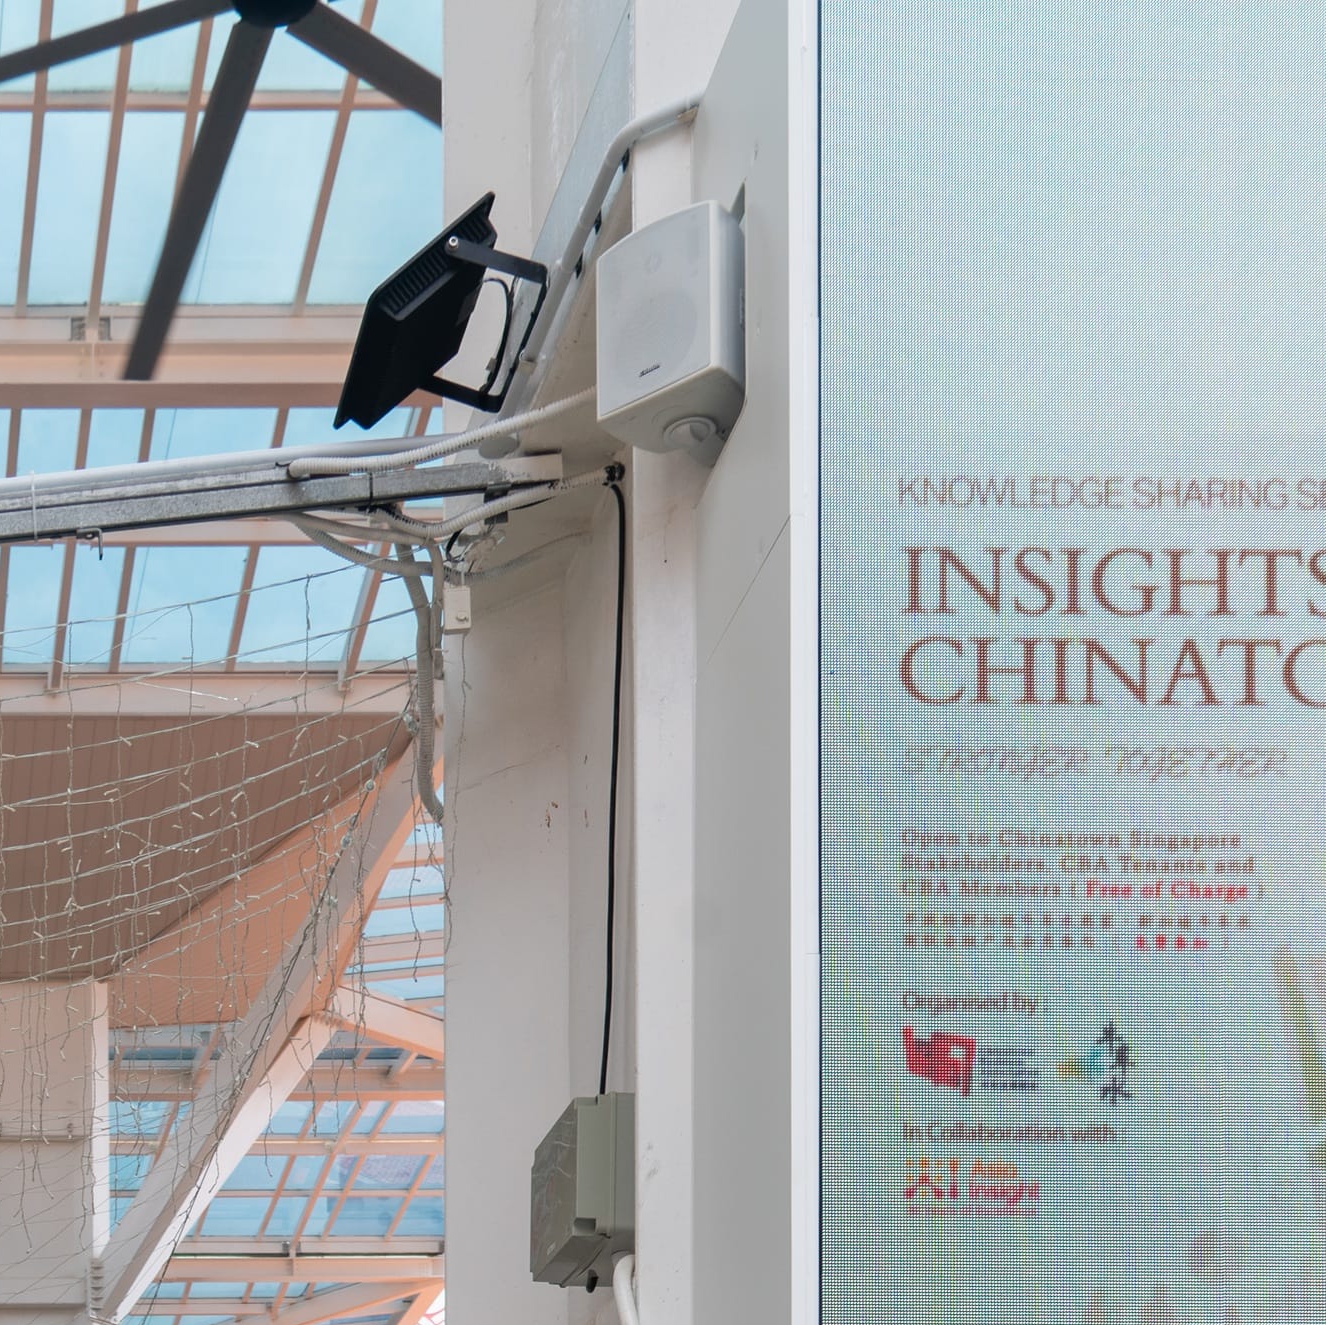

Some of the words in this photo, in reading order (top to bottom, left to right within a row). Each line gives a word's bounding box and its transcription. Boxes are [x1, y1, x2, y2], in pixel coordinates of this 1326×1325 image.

[897, 476, 1123, 508] KNOWLEDGE
[1132, 477, 1288, 509] SHARING
[900, 829, 960, 850] Open
[968, 831, 989, 847] to
[998, 829, 1120, 848] Chinatown
[1130, 830, 1241, 852] Singapore
[1215, 856, 1255, 873] and
[960, 878, 1060, 897] Members
[1086, 879, 1134, 898] Free
[1141, 879, 1164, 898] of
[1171, 879, 1249, 902] Charge
[902, 990, 1008, 1014] Organised
[903, 1123, 921, 1142] In
[927, 1121, 1065, 1142] Collaboration
